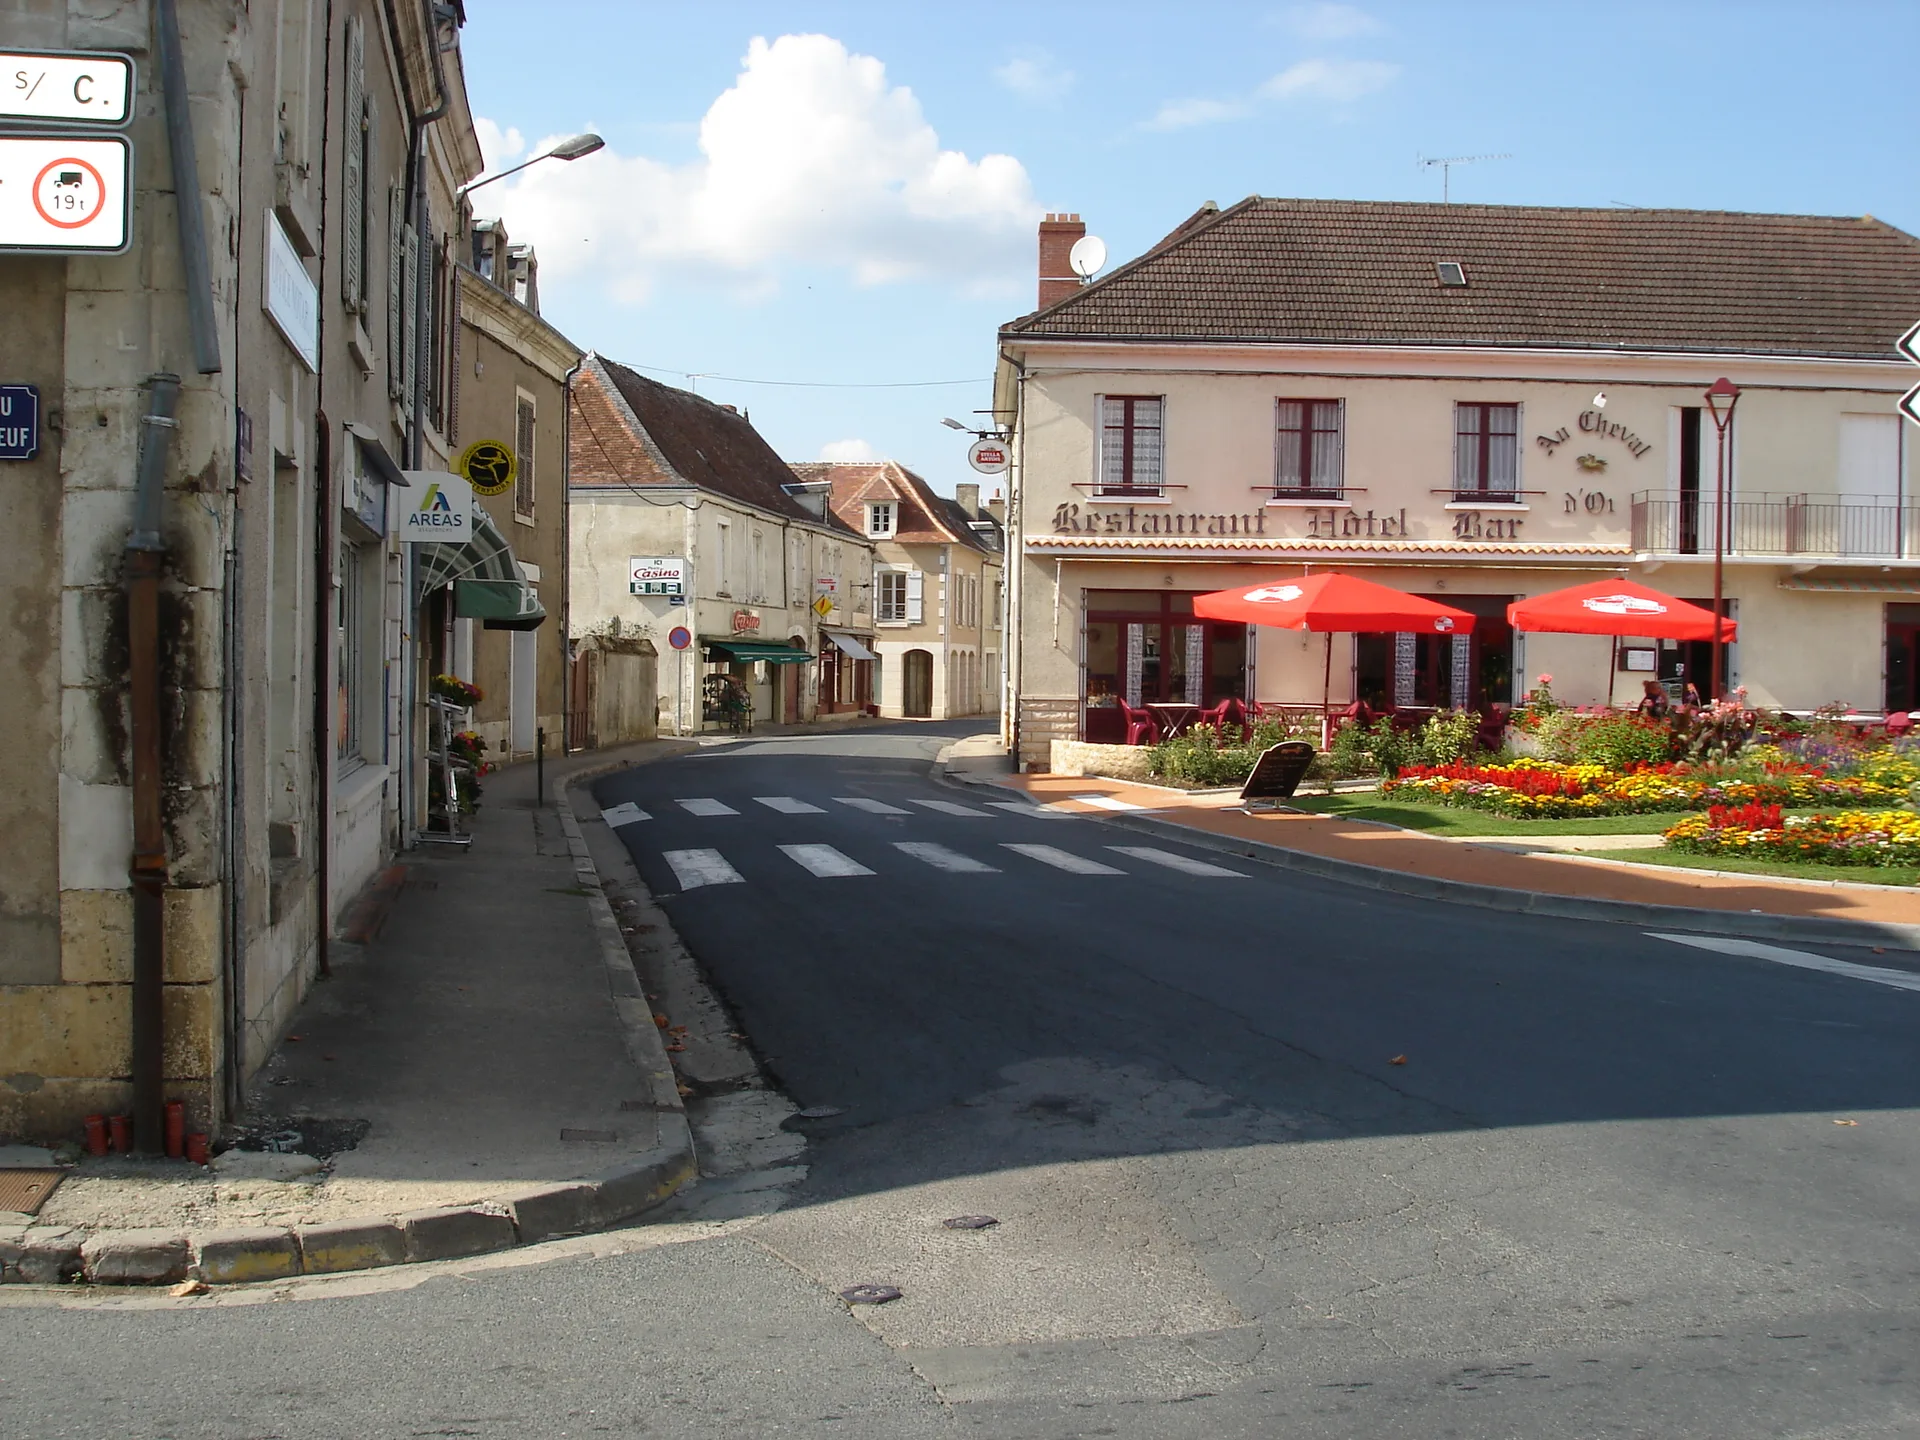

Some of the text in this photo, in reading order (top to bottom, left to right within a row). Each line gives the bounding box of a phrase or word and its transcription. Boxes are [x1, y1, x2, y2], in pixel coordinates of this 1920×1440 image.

[1537, 410, 1652, 459] Au Cheval
[409, 513, 462, 526] AREAS
[1052, 502, 1524, 539] Restaurant Hôtel Bar
[634, 568, 680, 579] Casino
